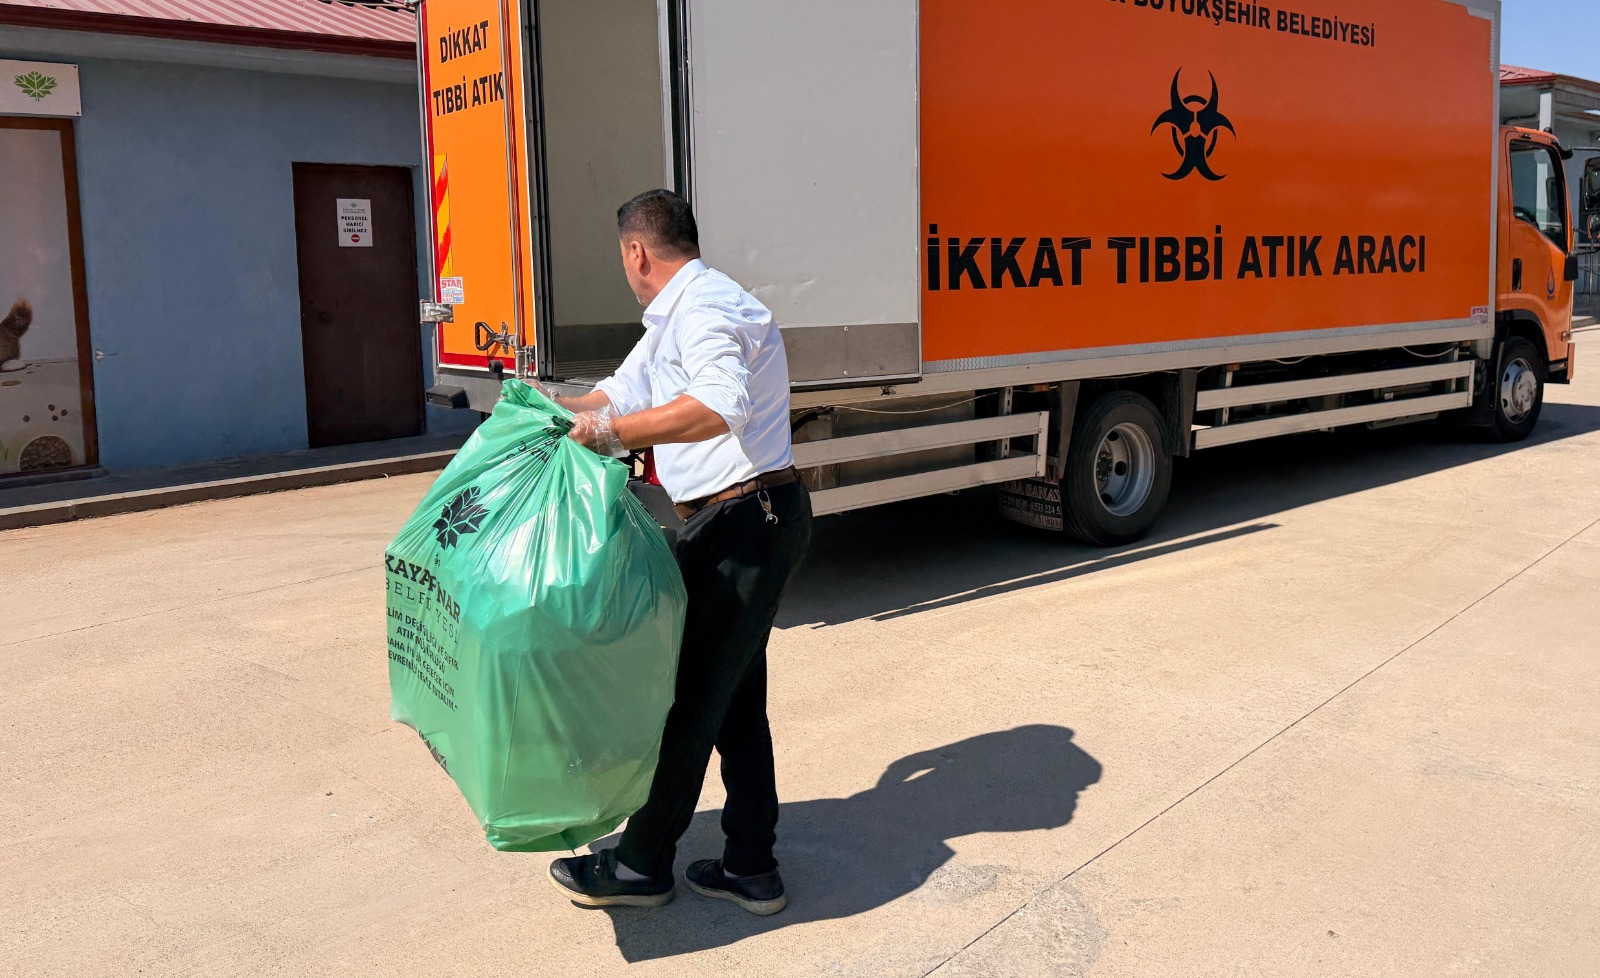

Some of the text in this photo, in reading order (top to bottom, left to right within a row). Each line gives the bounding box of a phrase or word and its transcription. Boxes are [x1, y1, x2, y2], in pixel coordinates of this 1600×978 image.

[440, 20, 488, 64] DİKKAT
[1276, 10, 1375, 48] BELEDİYESİ
[433, 71, 505, 117] TIBBİ ATIK
[927, 223, 1426, 291] İKKAT TIBBİ ATIK ARACI
[441, 279, 463, 290] STAR
